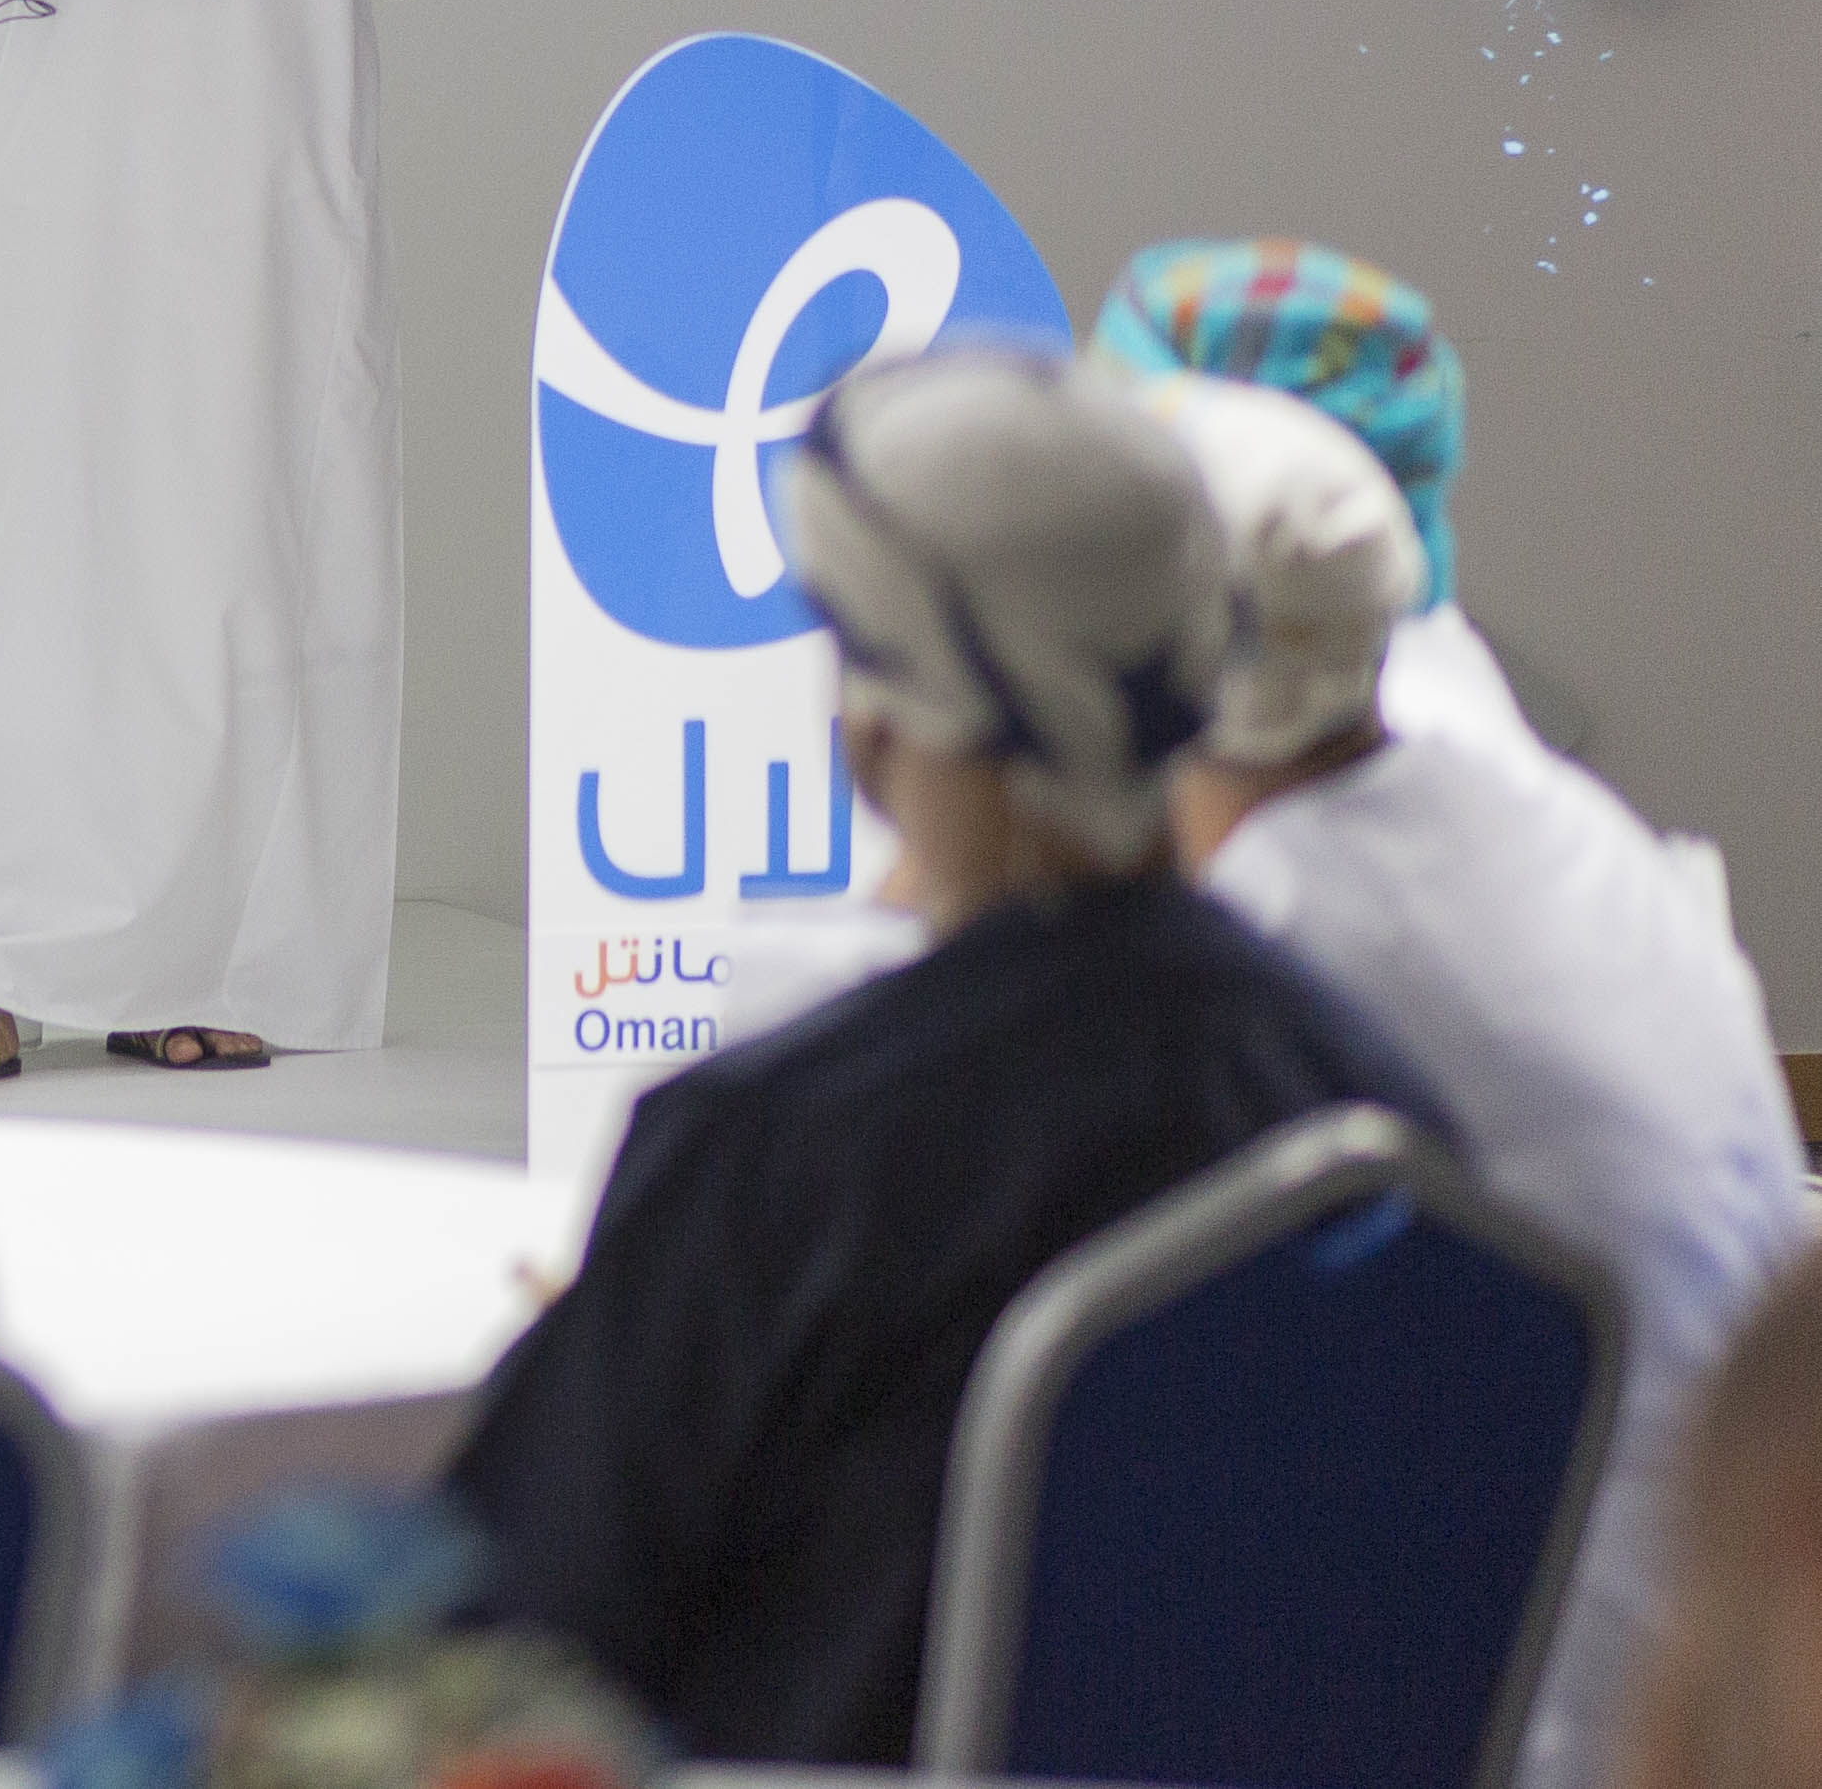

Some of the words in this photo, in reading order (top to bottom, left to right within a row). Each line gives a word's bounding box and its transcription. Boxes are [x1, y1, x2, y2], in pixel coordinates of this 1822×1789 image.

[577, 717, 853, 901] لال
[575, 938, 731, 999] مانتل
[575, 1009, 718, 1052] Oman
